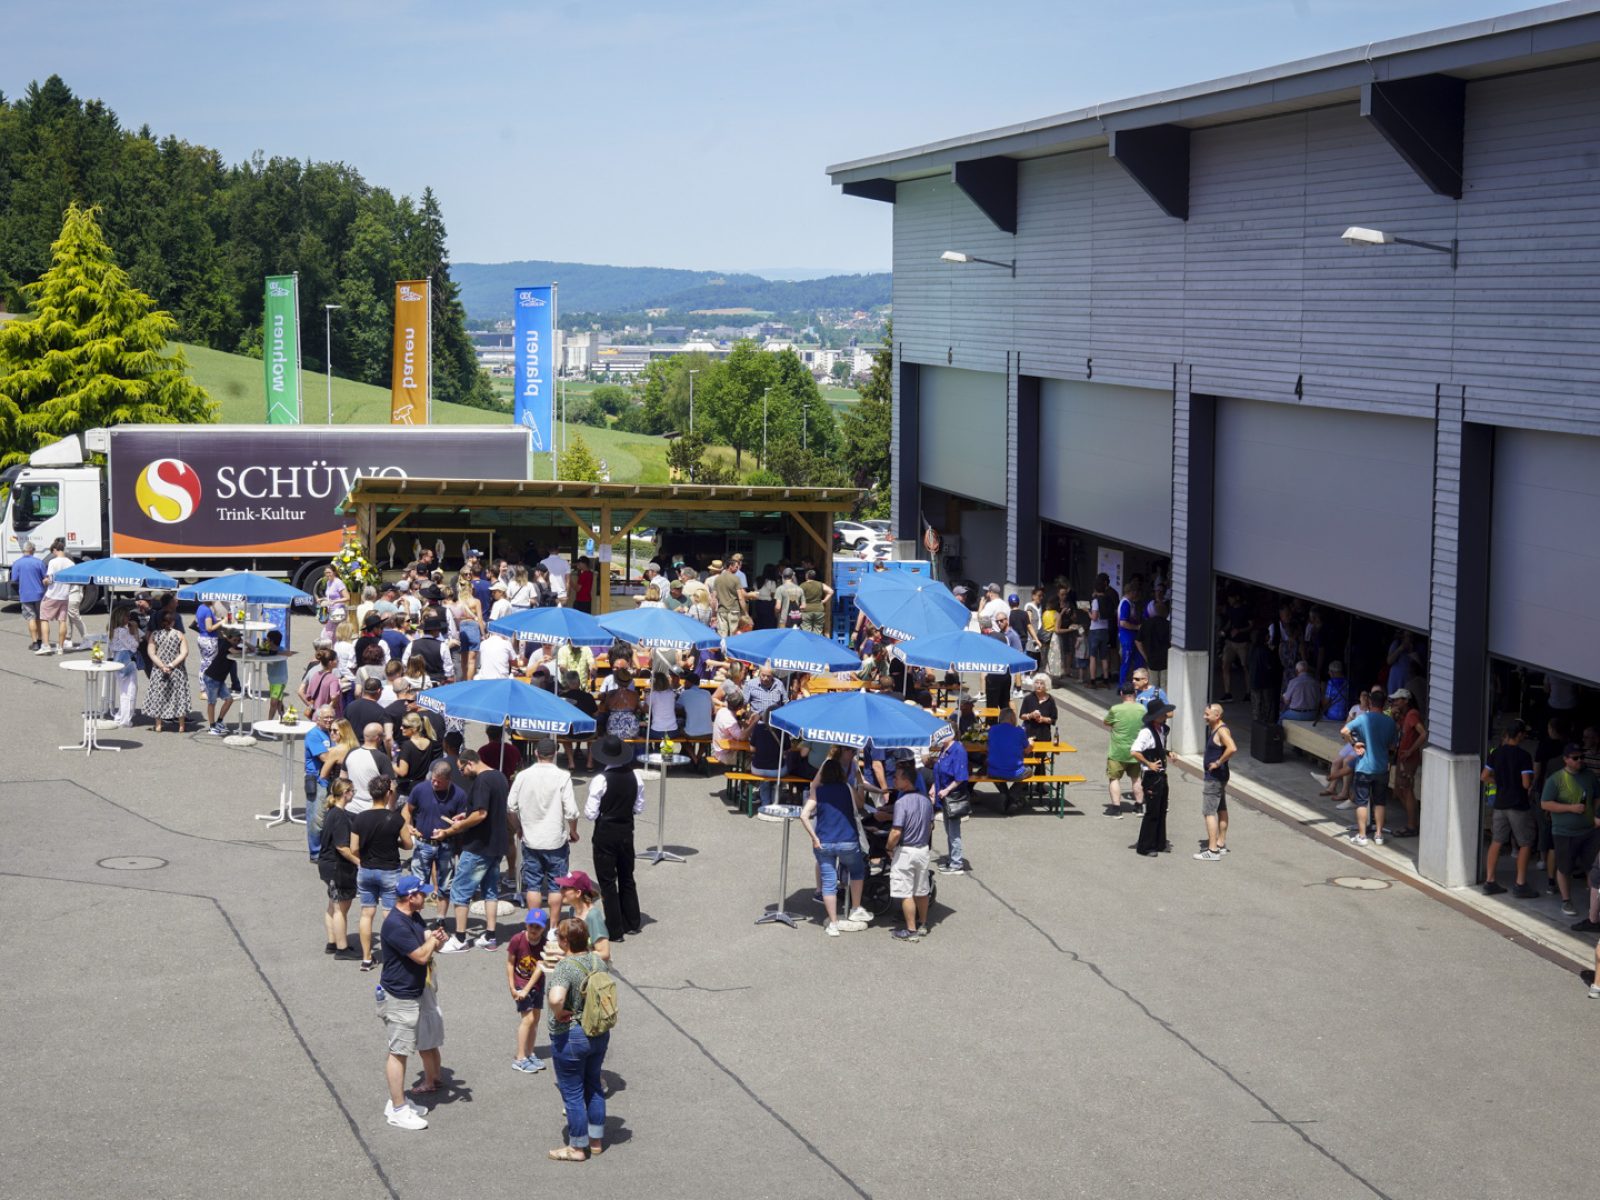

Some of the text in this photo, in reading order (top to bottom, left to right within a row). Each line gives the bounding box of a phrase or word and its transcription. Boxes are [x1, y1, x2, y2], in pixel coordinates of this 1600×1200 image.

[216, 507, 306, 521] Trink-Kultur
[96, 575, 142, 586] HENNIEZ
[201, 592, 243, 602] HENNIEZ
[519, 631, 566, 644] HENNIEZ
[885, 627, 916, 641] HENN
[645, 637, 692, 649] HENNIEZ
[773, 658, 824, 673] HENNIEZ
[957, 660, 1007, 673] HENNIEZ
[511, 717, 567, 732] HENNIEZ
[807, 728, 865, 746] HENNIEZ
